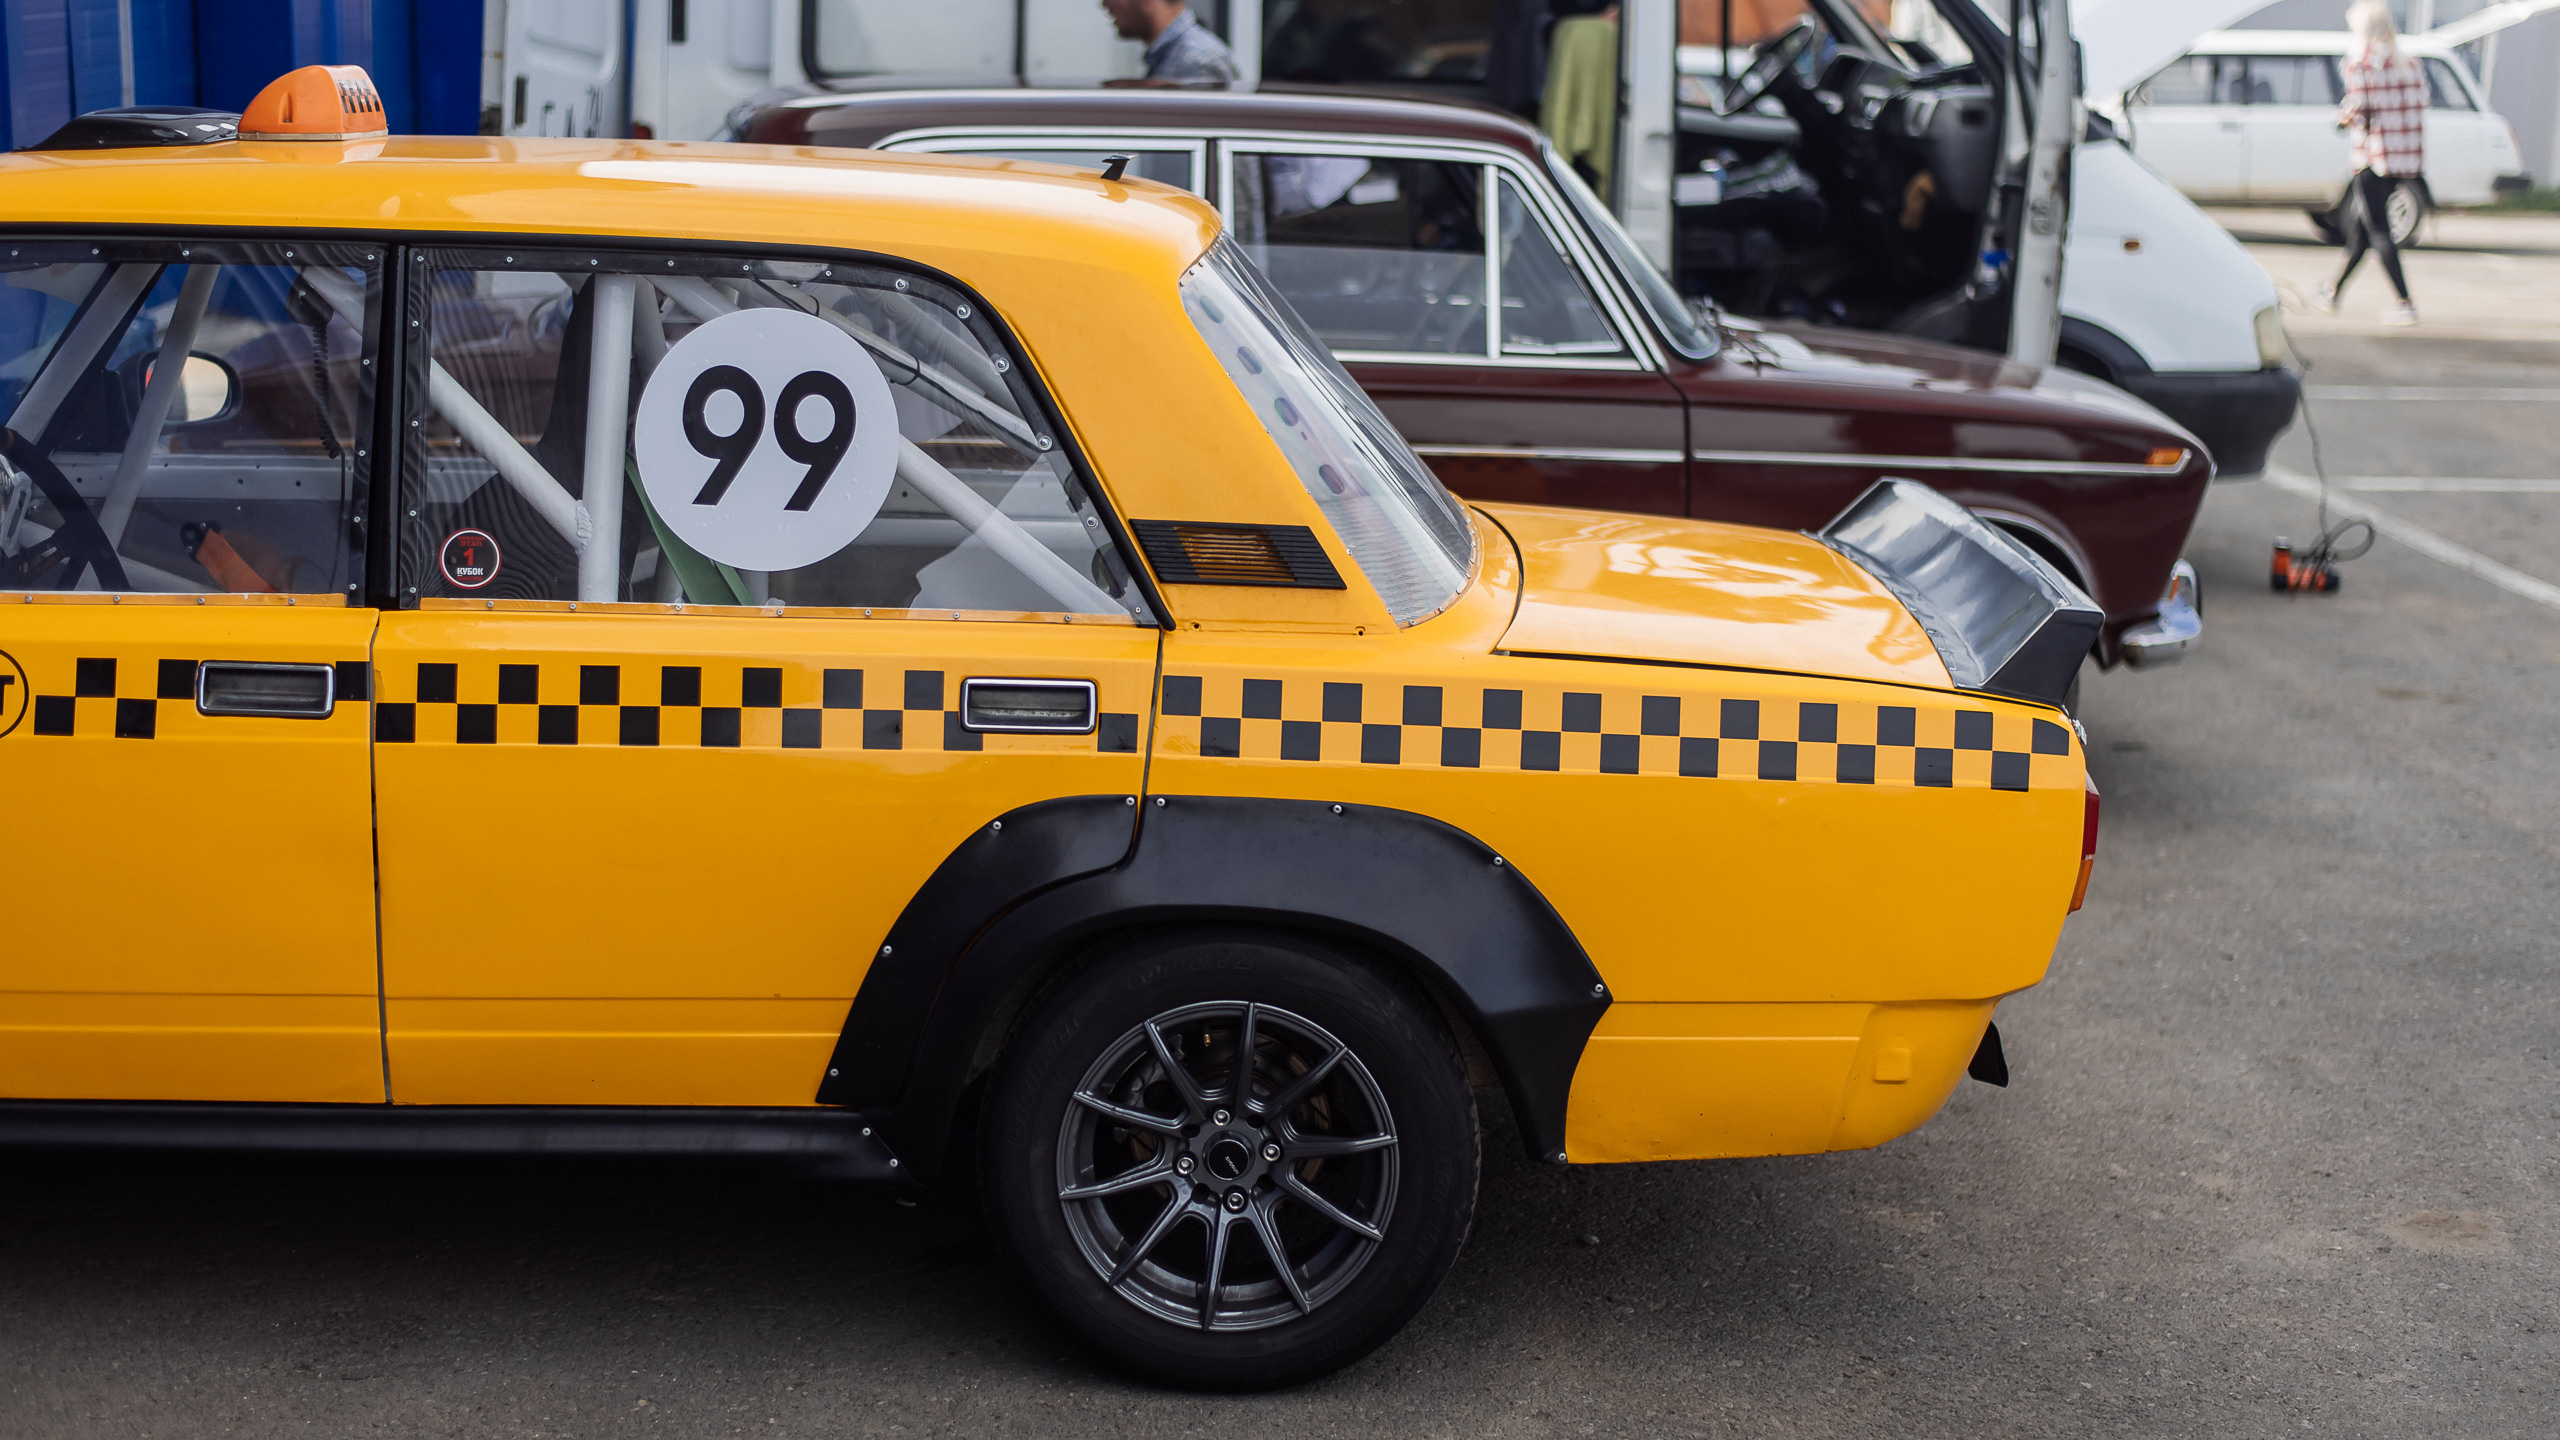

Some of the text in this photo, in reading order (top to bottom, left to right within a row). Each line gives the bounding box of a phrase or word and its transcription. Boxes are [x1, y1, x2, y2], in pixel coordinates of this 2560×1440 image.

[683, 365, 857, 512] 99
[463, 547, 474, 566] 1
[456, 567, 484, 576] КУБОК
